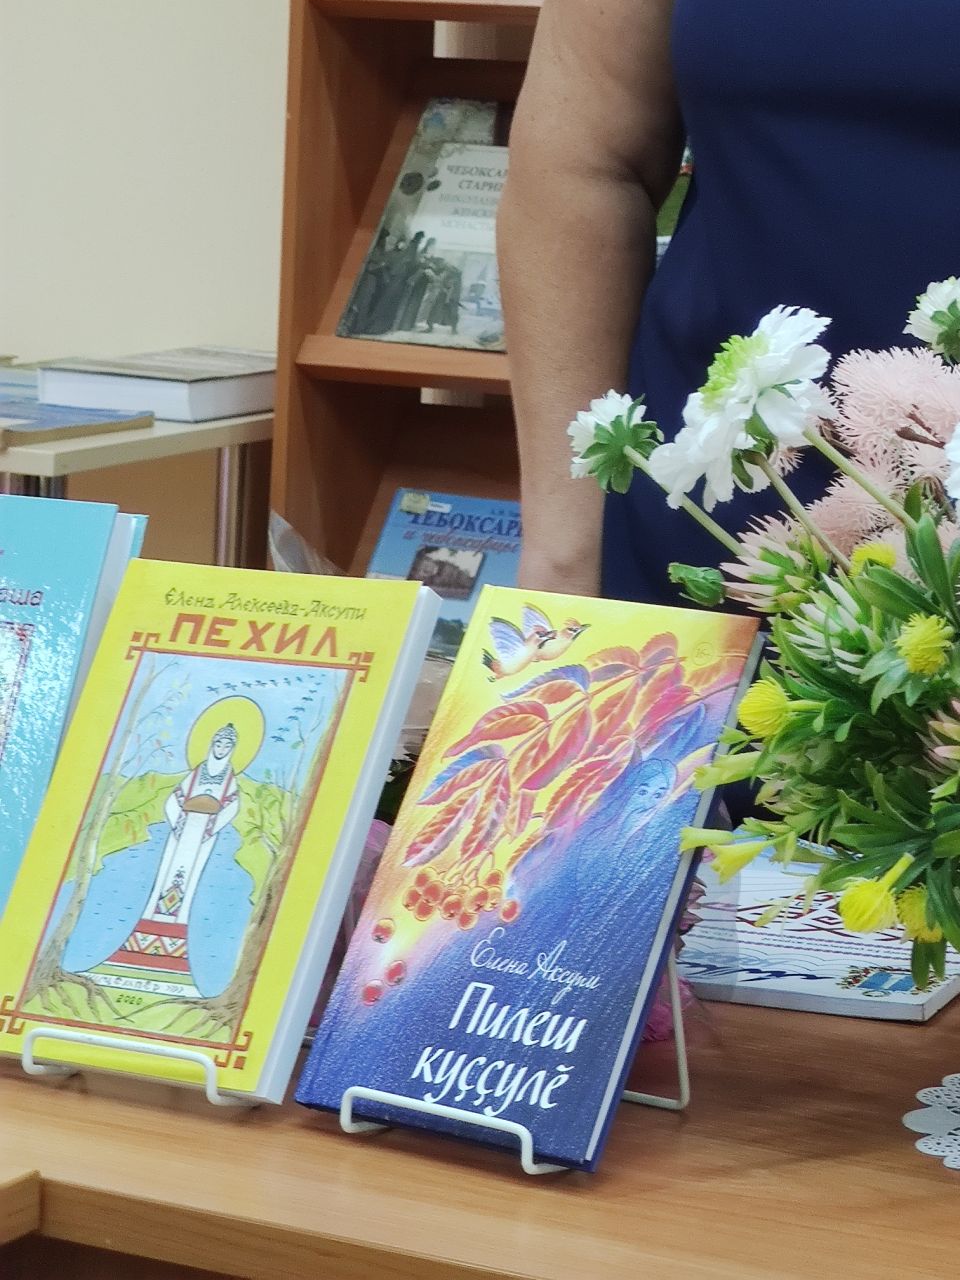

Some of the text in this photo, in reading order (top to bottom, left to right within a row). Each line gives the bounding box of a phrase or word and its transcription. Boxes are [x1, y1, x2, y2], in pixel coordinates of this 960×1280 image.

[169, 613, 338, 658] ПЕХИЛ
[471, 927, 529, 976] Елена
[448, 981, 588, 1054] Пилеш
